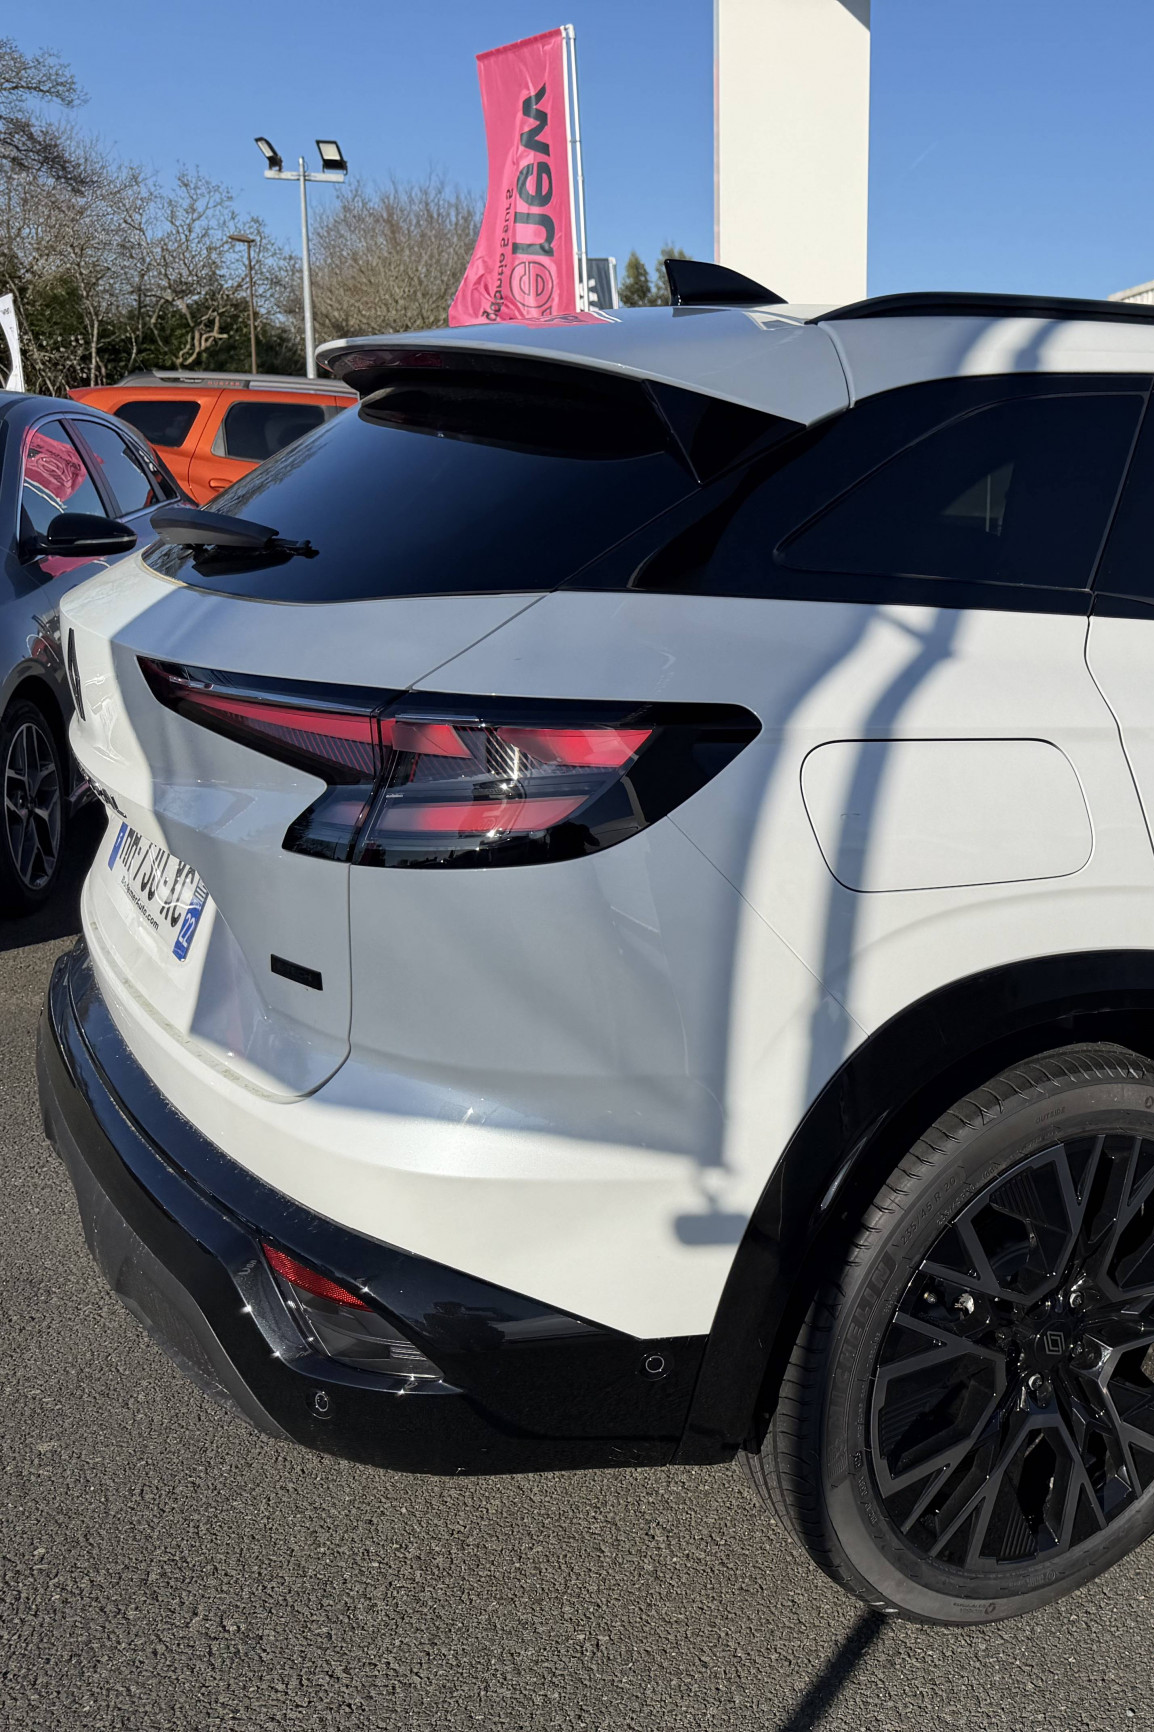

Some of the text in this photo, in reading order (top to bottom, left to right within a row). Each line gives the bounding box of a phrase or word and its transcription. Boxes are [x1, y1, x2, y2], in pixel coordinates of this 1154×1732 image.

[178, 912, 196, 948] 22
[900, 1203, 933, 1246] 235/45
[827, 1259, 892, 1431] MICHELIN
